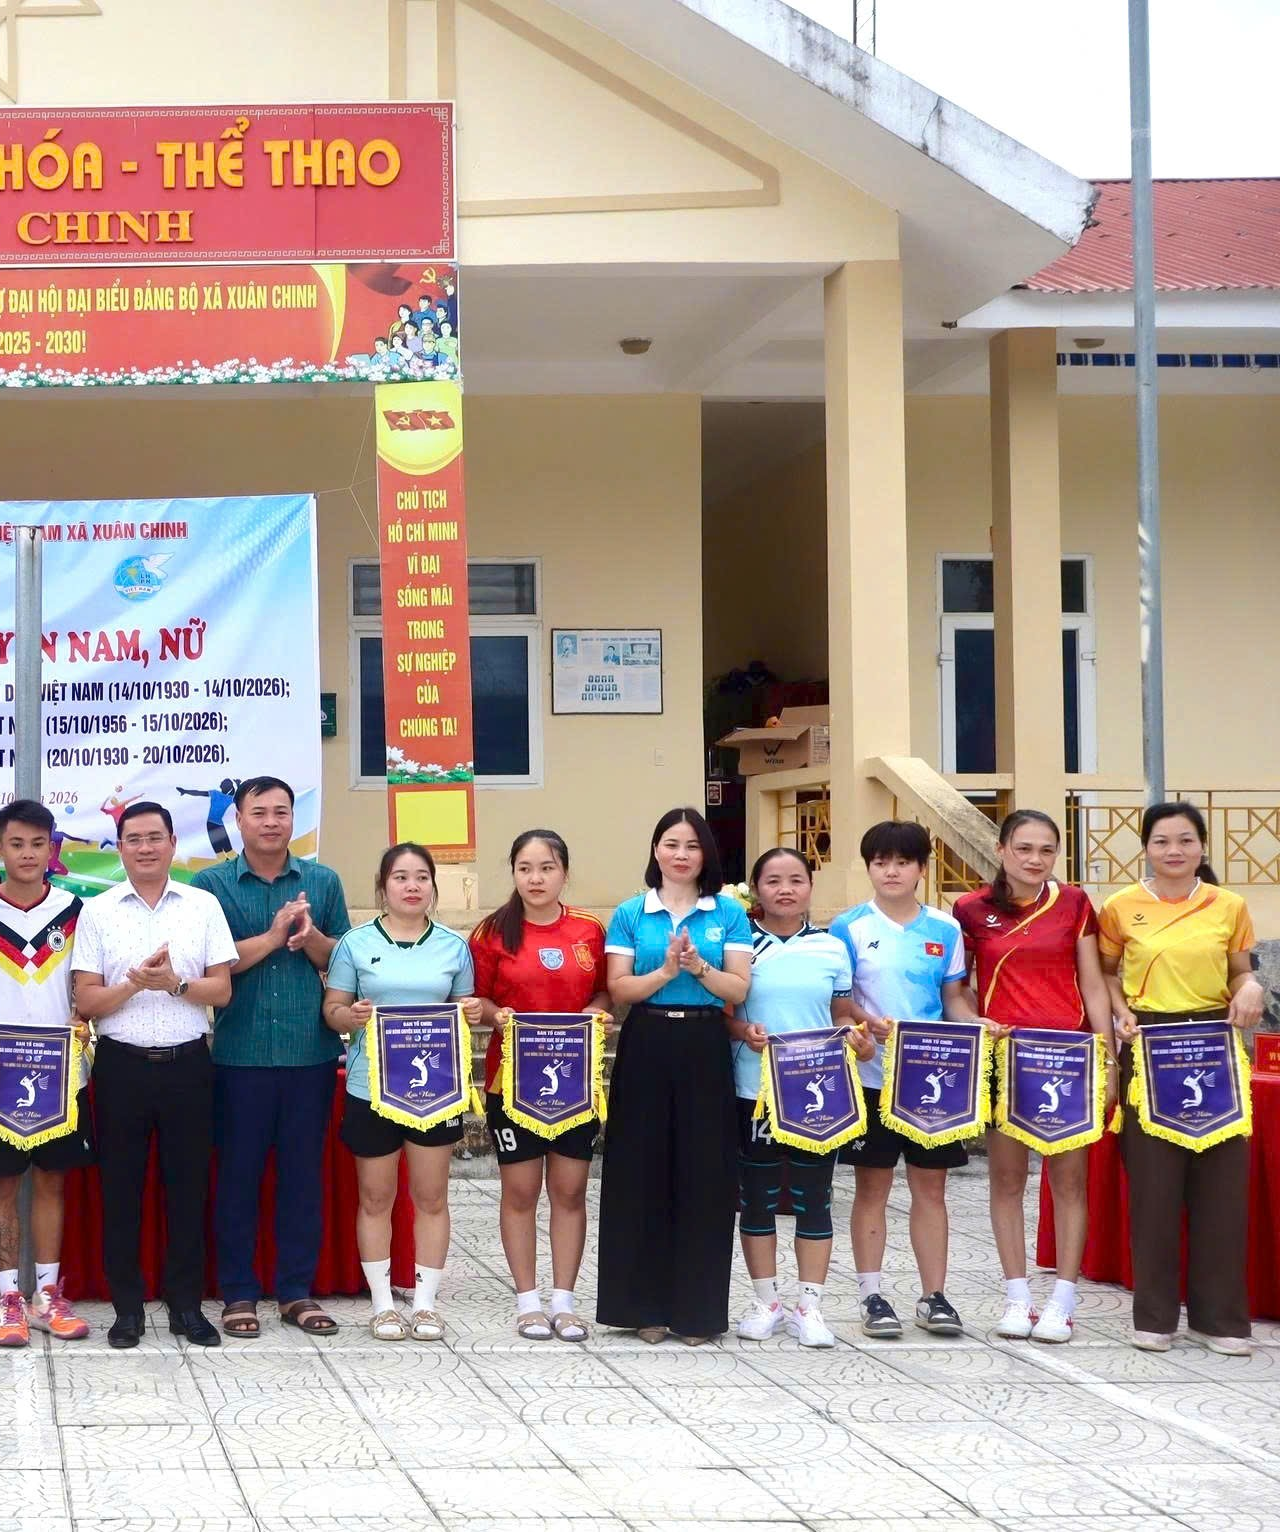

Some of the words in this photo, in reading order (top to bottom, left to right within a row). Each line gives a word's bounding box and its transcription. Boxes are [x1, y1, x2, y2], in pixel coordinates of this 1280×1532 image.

[121, 161, 139, 174] -
[156, 116, 250, 189] THỂ
[263, 138, 402, 188] THAO
[16, 209, 195, 245] CHINH
[8, 289, 33, 319] ĐẠI
[37, 283, 62, 318] HỘI
[67, 288, 92, 318] ĐẠI
[95, 278, 129, 312] BIỂU
[133, 279, 174, 311] ĐẢNG
[178, 281, 199, 316] BỘ
[203, 281, 223, 310] XÃ
[227, 280, 267, 310] XUÂN
[271, 284, 317, 309] CHINH
[45, 329, 87, 354] 2030!
[396, 485, 419, 511] CHỦ
[422, 489, 447, 515] TỊCH
[66, 522, 89, 541] XÃ
[92, 520, 136, 541] XUÂN
[139, 521, 188, 540] CHINH
[387, 517, 403, 543] HỒ
[406, 518, 425, 542] CHÍ
[428, 521, 458, 541] MINH
[407, 551, 418, 575] VĨ
[420, 554, 440, 578] ĐẠI
[397, 581, 428, 608] SỐNG
[430, 582, 453, 607] MÃI
[407, 619, 445, 640] TRONG
[68, 630, 149, 669] NAM,
[159, 617, 207, 661] NỮ
[397, 651, 414, 677] SỰ
[415, 648, 457, 675] NGHIỆP
[71, 682, 104, 702] NAM
[108, 681, 190, 704] (14/10/1930
[203, 678, 290, 701] 14/10/2026);
[416, 678, 440, 705] CỦA
[46, 714, 127, 737] (15/10/1956
[141, 711, 228, 733] 15/10/2026);
[399, 714, 438, 738] CHÚNG
[440, 717, 458, 737] TA!
[47, 746, 129, 769] (20/10/1930
[143, 745, 230, 765] 20/10/2026).
[49, 791, 78, 805] 2026
[494, 1127, 517, 1152] 19
